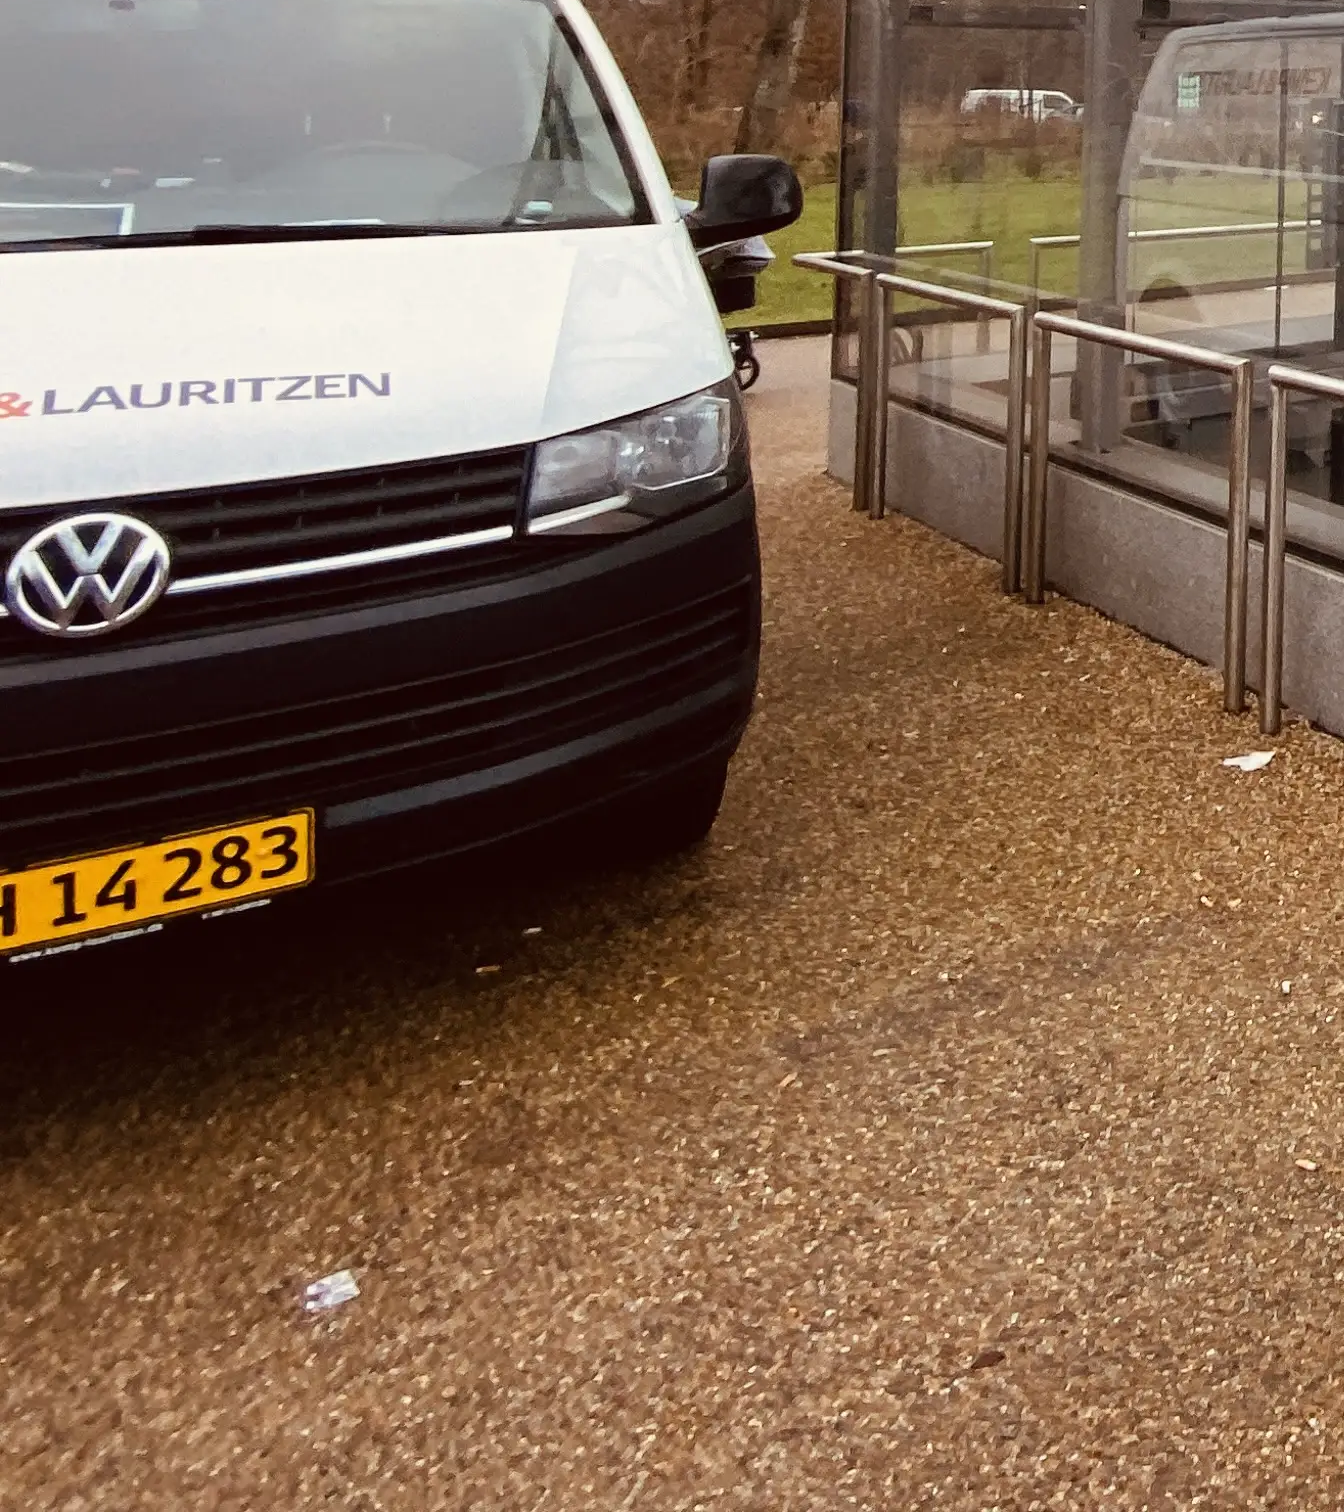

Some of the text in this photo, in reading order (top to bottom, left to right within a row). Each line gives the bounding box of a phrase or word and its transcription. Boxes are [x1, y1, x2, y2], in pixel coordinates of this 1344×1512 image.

[41, 372, 391, 416] LAURITZEN
[52, 858, 138, 927] 14
[162, 825, 298, 903] 283
